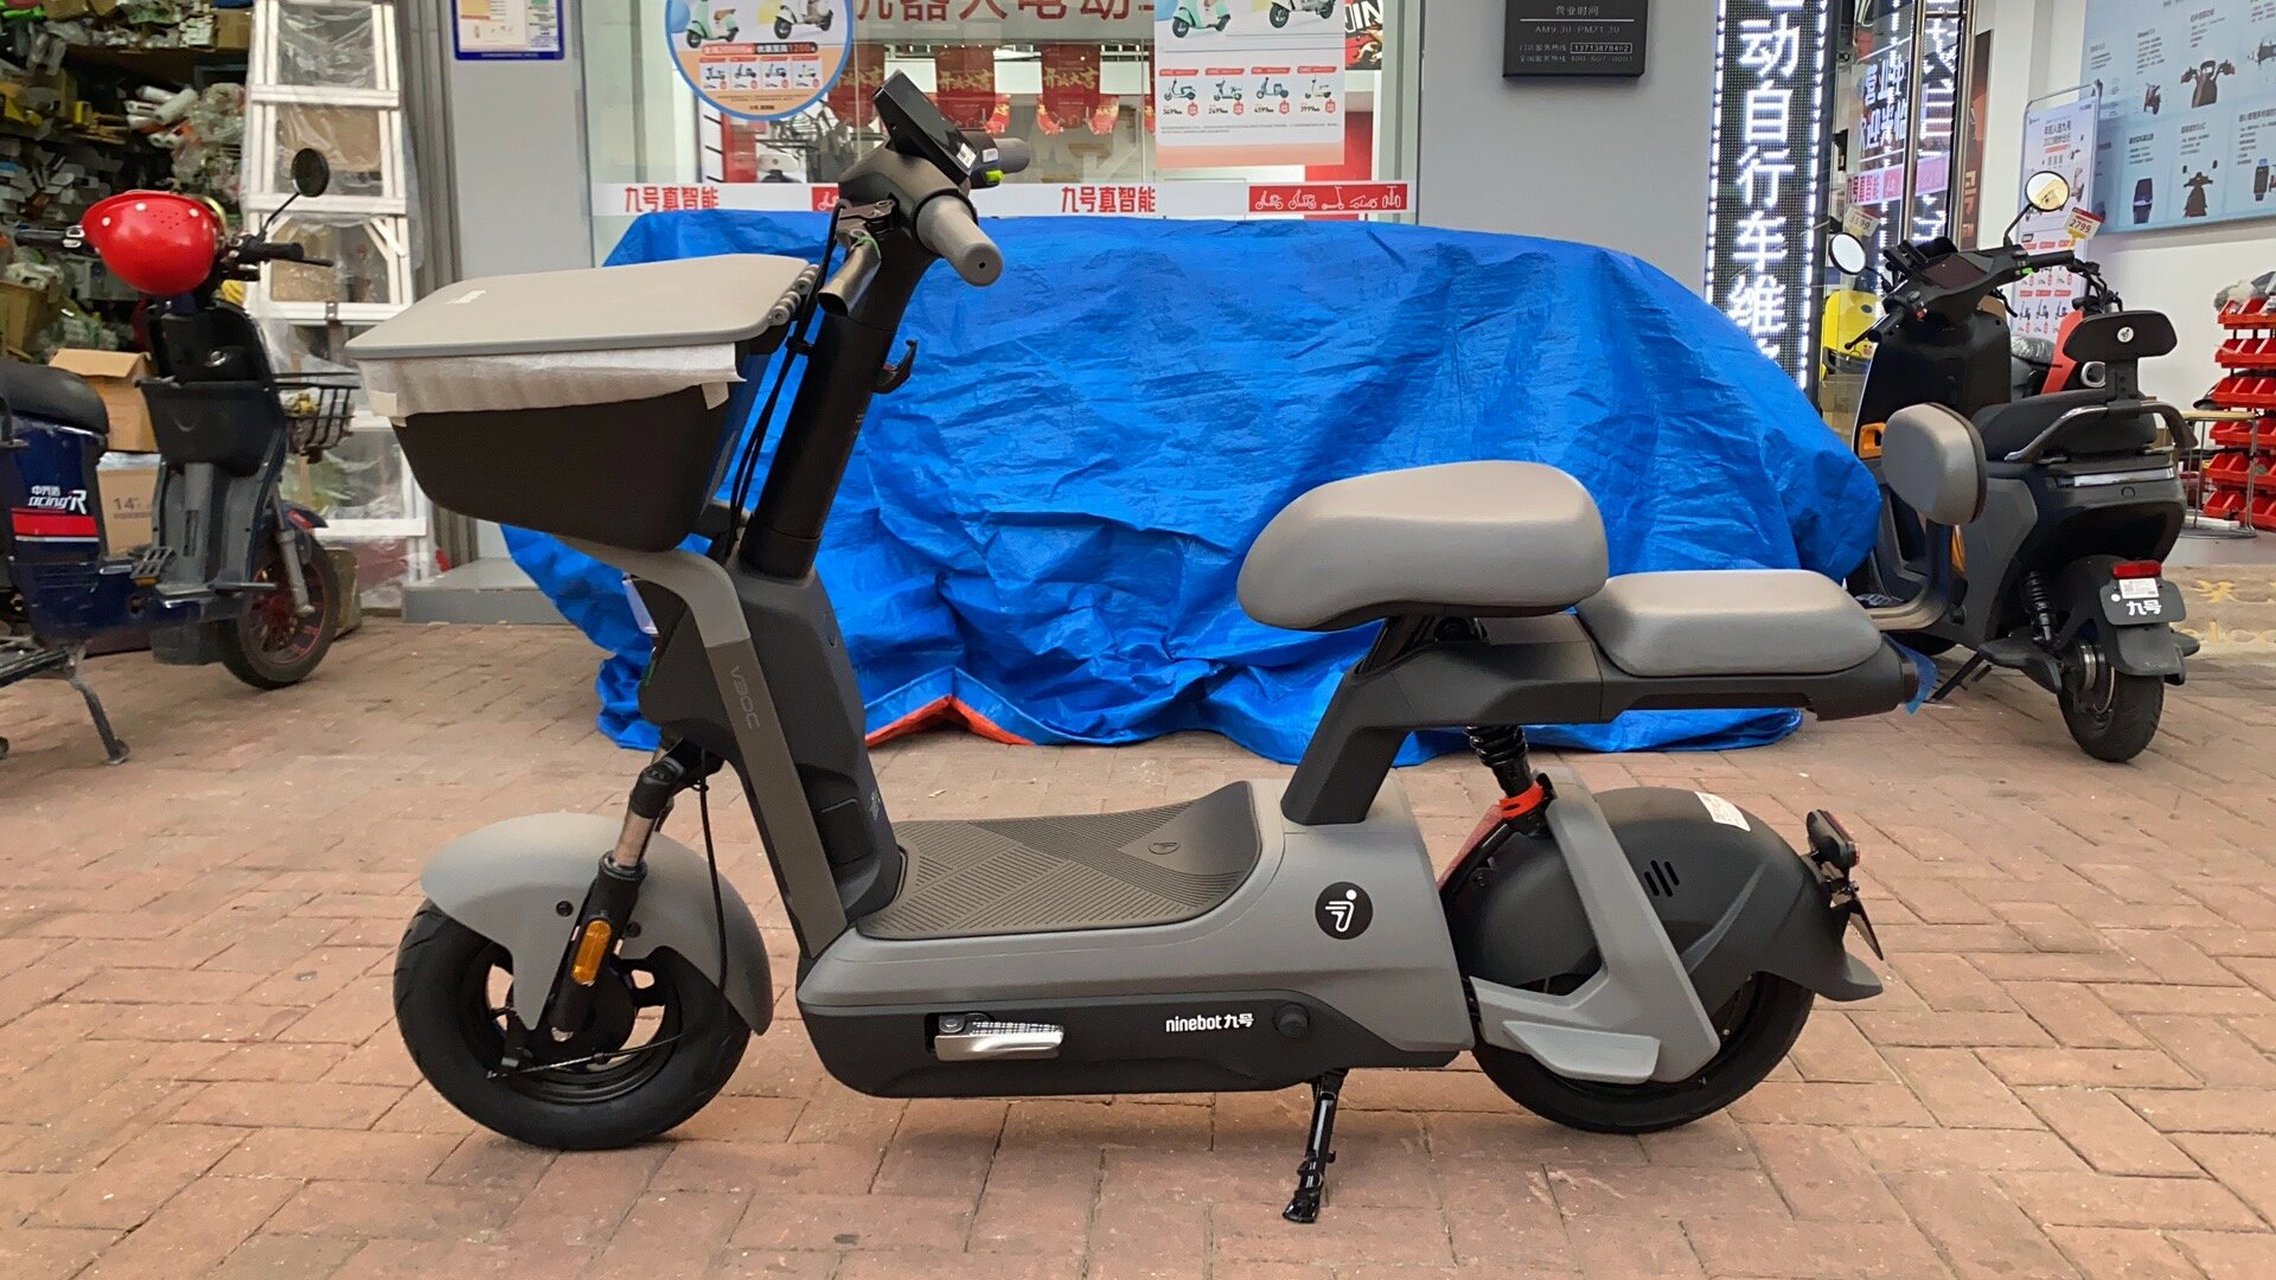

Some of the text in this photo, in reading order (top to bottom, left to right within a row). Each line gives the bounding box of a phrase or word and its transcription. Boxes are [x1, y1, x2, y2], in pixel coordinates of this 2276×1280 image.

[1727, 0, 1804, 359] 动自行车维
[624, 185, 720, 212] 九号真智能
[1061, 186, 1156, 213] 九号真智能
[2069, 218, 2092, 233] 2799
[2126, 599, 2162, 616] 九号
[1165, 1012, 1254, 1032] ninebot 九号
